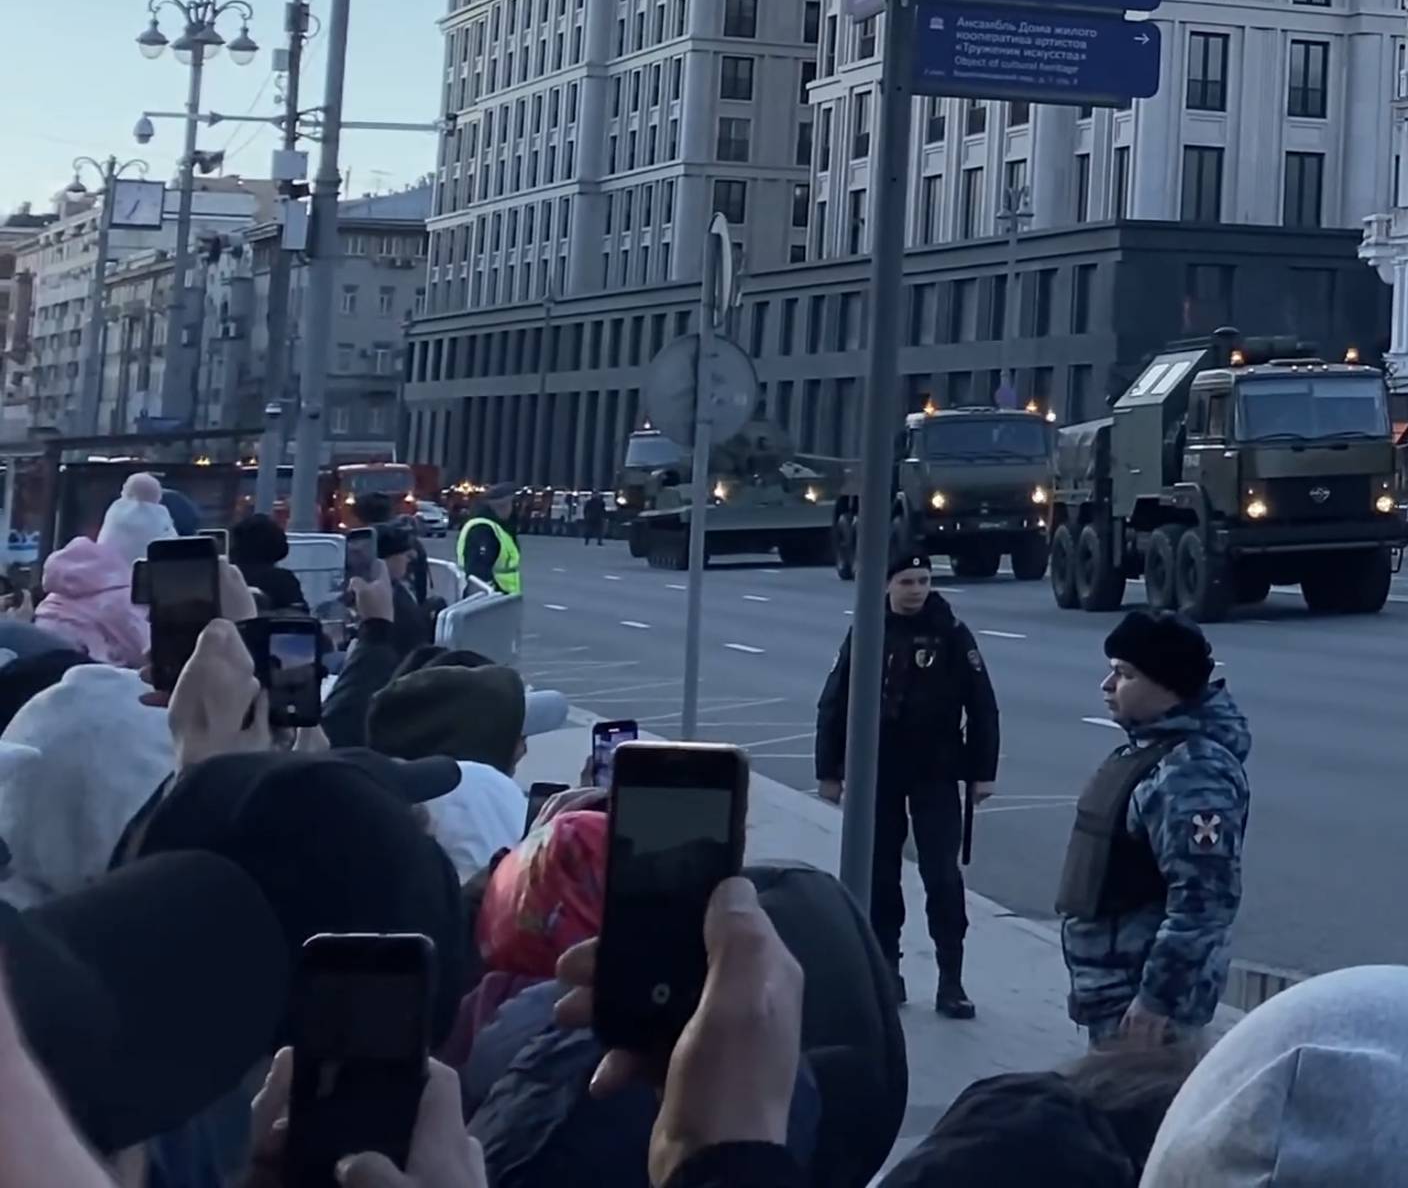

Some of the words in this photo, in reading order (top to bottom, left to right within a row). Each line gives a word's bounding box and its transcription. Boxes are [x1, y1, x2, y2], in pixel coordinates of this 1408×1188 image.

[956, 16, 1017, 31] Ансамбль
[1018, 20, 1051, 34] Дома
[1054, 27, 1097, 38] жилого
[956, 30, 1032, 46] кооператива
[1034, 38, 1088, 50] артистов
